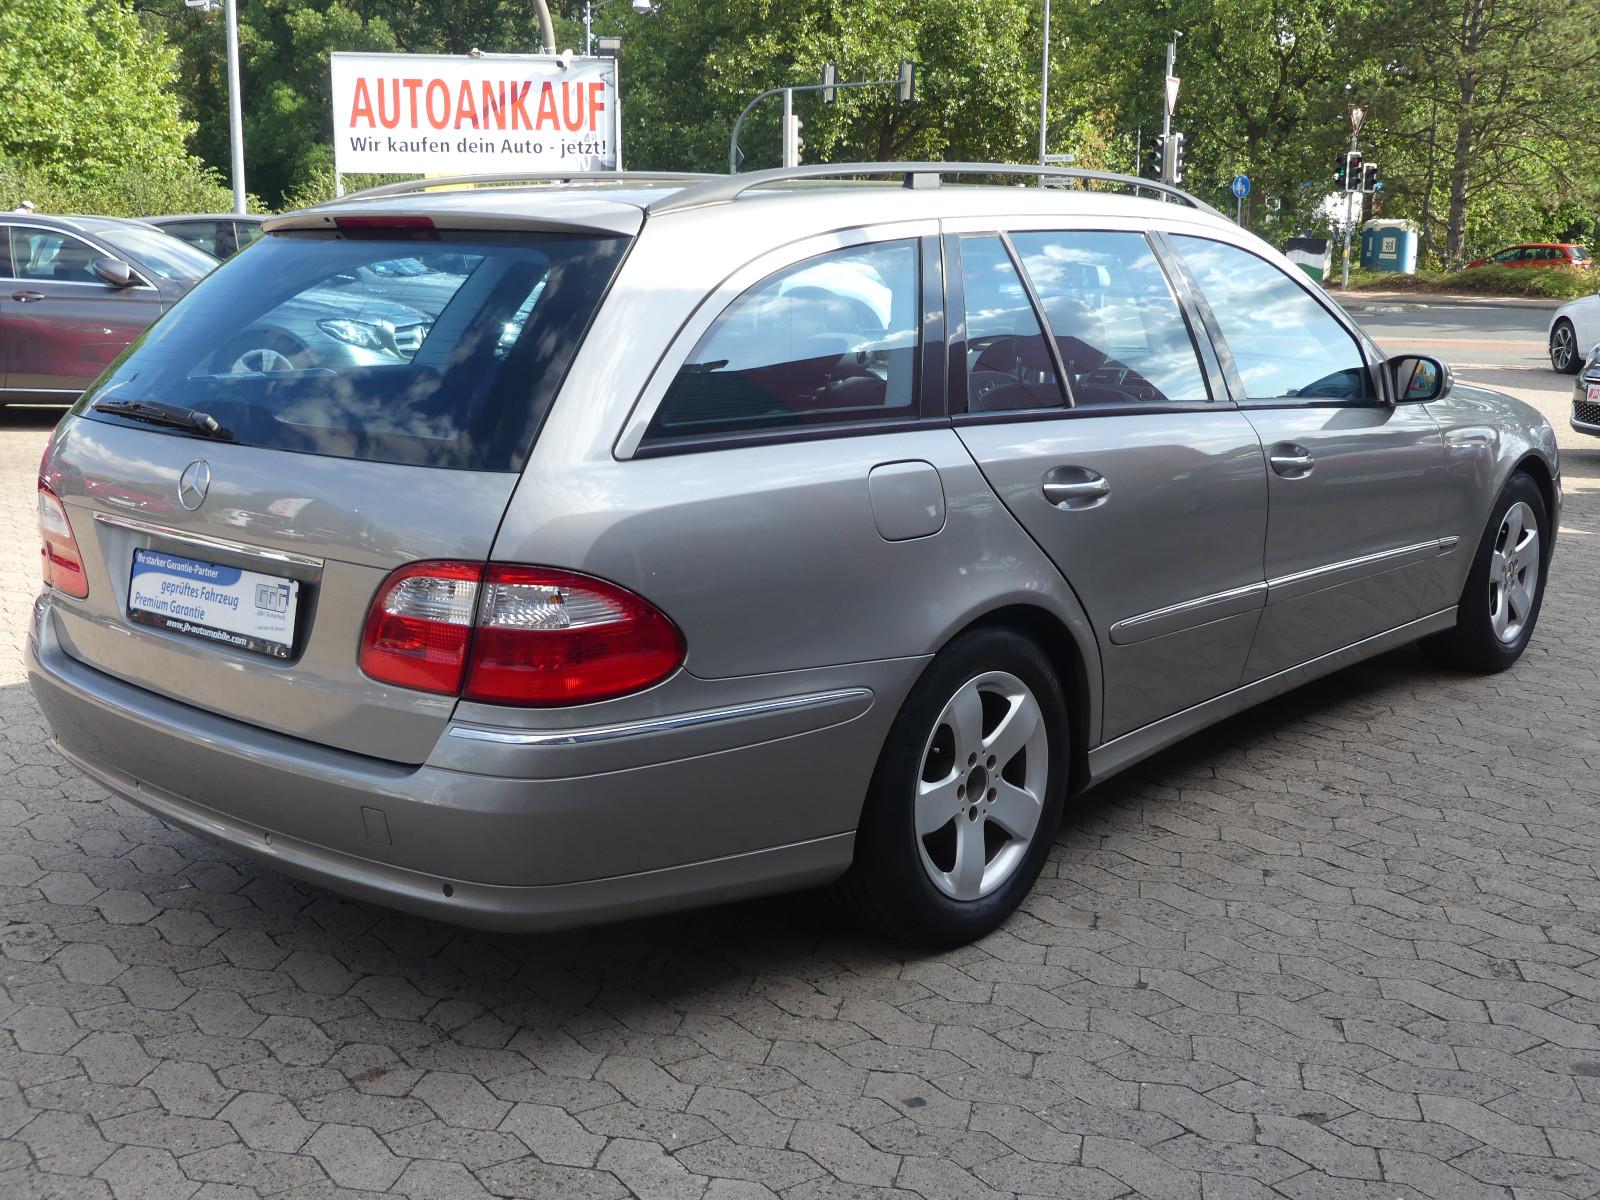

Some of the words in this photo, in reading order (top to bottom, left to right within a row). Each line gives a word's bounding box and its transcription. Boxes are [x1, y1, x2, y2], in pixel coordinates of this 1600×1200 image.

[349, 77, 605, 132] AUTOANKAUF
[350, 137, 381, 153] Wir
[387, 137, 450, 153] kaufen
[457, 138, 495, 154] dein
[500, 139, 543, 154] Auto
[559, 138, 606, 159] jetzt!
[137, 552, 147, 563] Ihr
[146, 555, 167, 568] starker
[166, 559, 219, 579] Garantie-Partner
[134, 591, 169, 611] Premium
[169, 600, 206, 620] Garantie
[161, 580, 199, 599] geprüftes
[200, 586, 240, 611] Fahrzeug
[166, 619, 247, 646] www.jh-automobile.com
